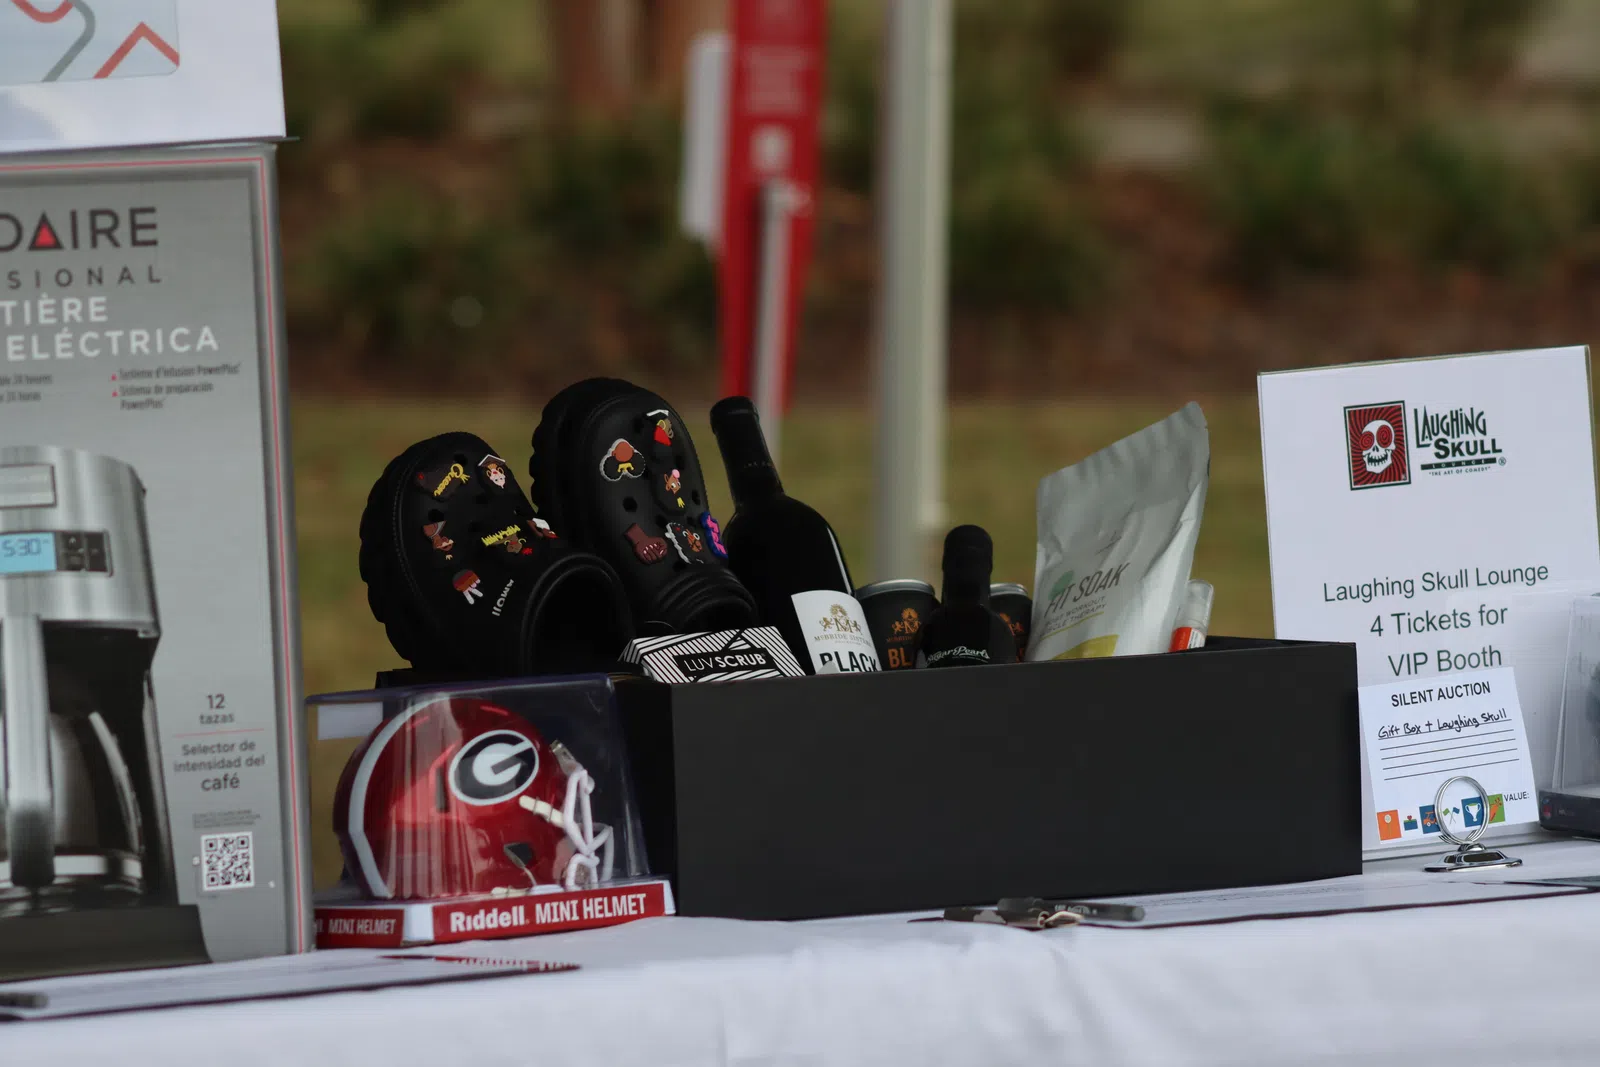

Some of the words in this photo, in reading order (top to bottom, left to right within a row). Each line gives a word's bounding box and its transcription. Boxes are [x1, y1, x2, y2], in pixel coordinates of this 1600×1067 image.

[7, 265, 162, 290] SIONAL
[6, 326, 219, 361] ELÉCTRICA
[1434, 437, 1503, 459] SKULL
[1432, 458, 1485, 468] LOUNGE
[1073, 563, 1131, 602] SOAK
[1323, 576, 1415, 604] Laughing
[1421, 568, 1469, 592] Skull
[1476, 565, 1549, 587] Lounge
[1370, 615, 1384, 637] 4
[1391, 610, 1471, 635] Tickets
[1479, 604, 1508, 627] for
[1388, 652, 1428, 677] VIP
[1437, 645, 1502, 672] Booth
[207, 694, 225, 709] 12
[1391, 689, 1434, 707] SILENT
[1438, 681, 1491, 700] AUCTION
[200, 713, 234, 725] tazas
[1378, 726, 1400, 739] Gift
[1404, 723, 1421, 734] Box
[1437, 716, 1479, 732] Laughing
[1481, 708, 1507, 723] Skull
[182, 743, 235, 756] Selector
[239, 740, 255, 751] de
[245, 755, 265, 768] del
[454, 734, 535, 800] G
[202, 773, 240, 792] café
[1504, 791, 1530, 802] VALUE:
[450, 905, 525, 933] Riddell
[535, 900, 578, 924] MINI
[583, 893, 646, 919] HELMET
[328, 918, 355, 934] MINI
[356, 919, 397, 934] HELMET
